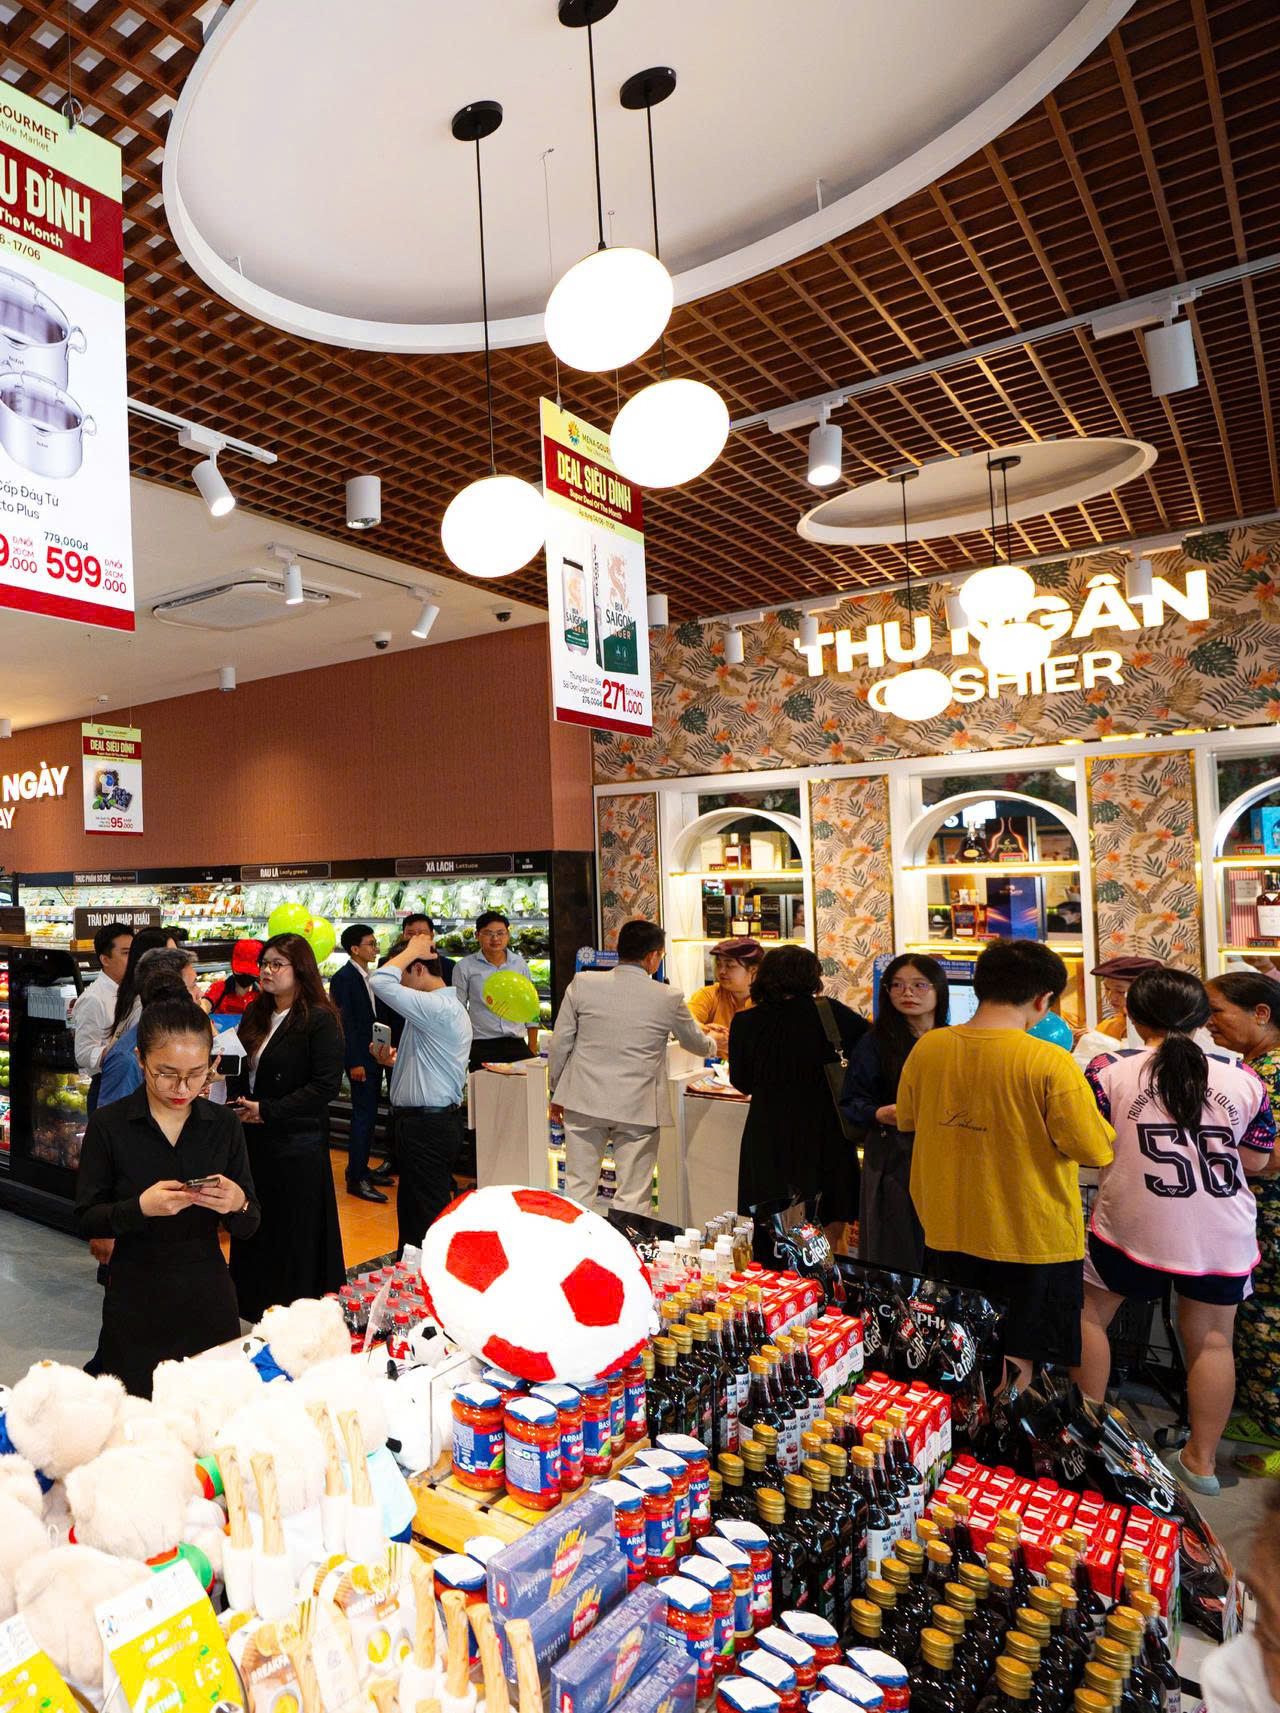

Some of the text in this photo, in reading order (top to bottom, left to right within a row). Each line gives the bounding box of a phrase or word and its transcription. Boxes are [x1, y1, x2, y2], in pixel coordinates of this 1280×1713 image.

[20, 131, 50, 153] Market
[25, 169, 91, 243] ĐỈNH
[23, 216, 63, 249] Month
[12, 239, 41, 262] 17/06
[557, 450, 582, 489] DEAL
[584, 465, 607, 501] SIÊU
[20, 486, 43, 507] Đáy
[16, 502, 40, 520] Plus
[44, 531, 89, 551] 779,000đ
[9, 557, 38, 574] .000
[46, 545, 102, 588] 599
[102, 578, 127, 594] .000
[606, 609, 632, 627] SAIGON
[794, 615, 932, 677] THU
[867, 650, 1124, 713] CSHIER
[602, 679, 626, 712] 271
[627, 700, 643, 715] .000
[2, 761, 70, 801] NGÀY
[110, 817, 124, 829] 95
[260, 868, 272, 878] RAU
[87, 912, 102, 926] TRÁI
[102, 912, 115, 926] CÂY
[133, 909, 150, 926] KHẨU
[1127, 1093, 1149, 1122] TRUNG
[1136, 1123, 1242, 1199] 56
